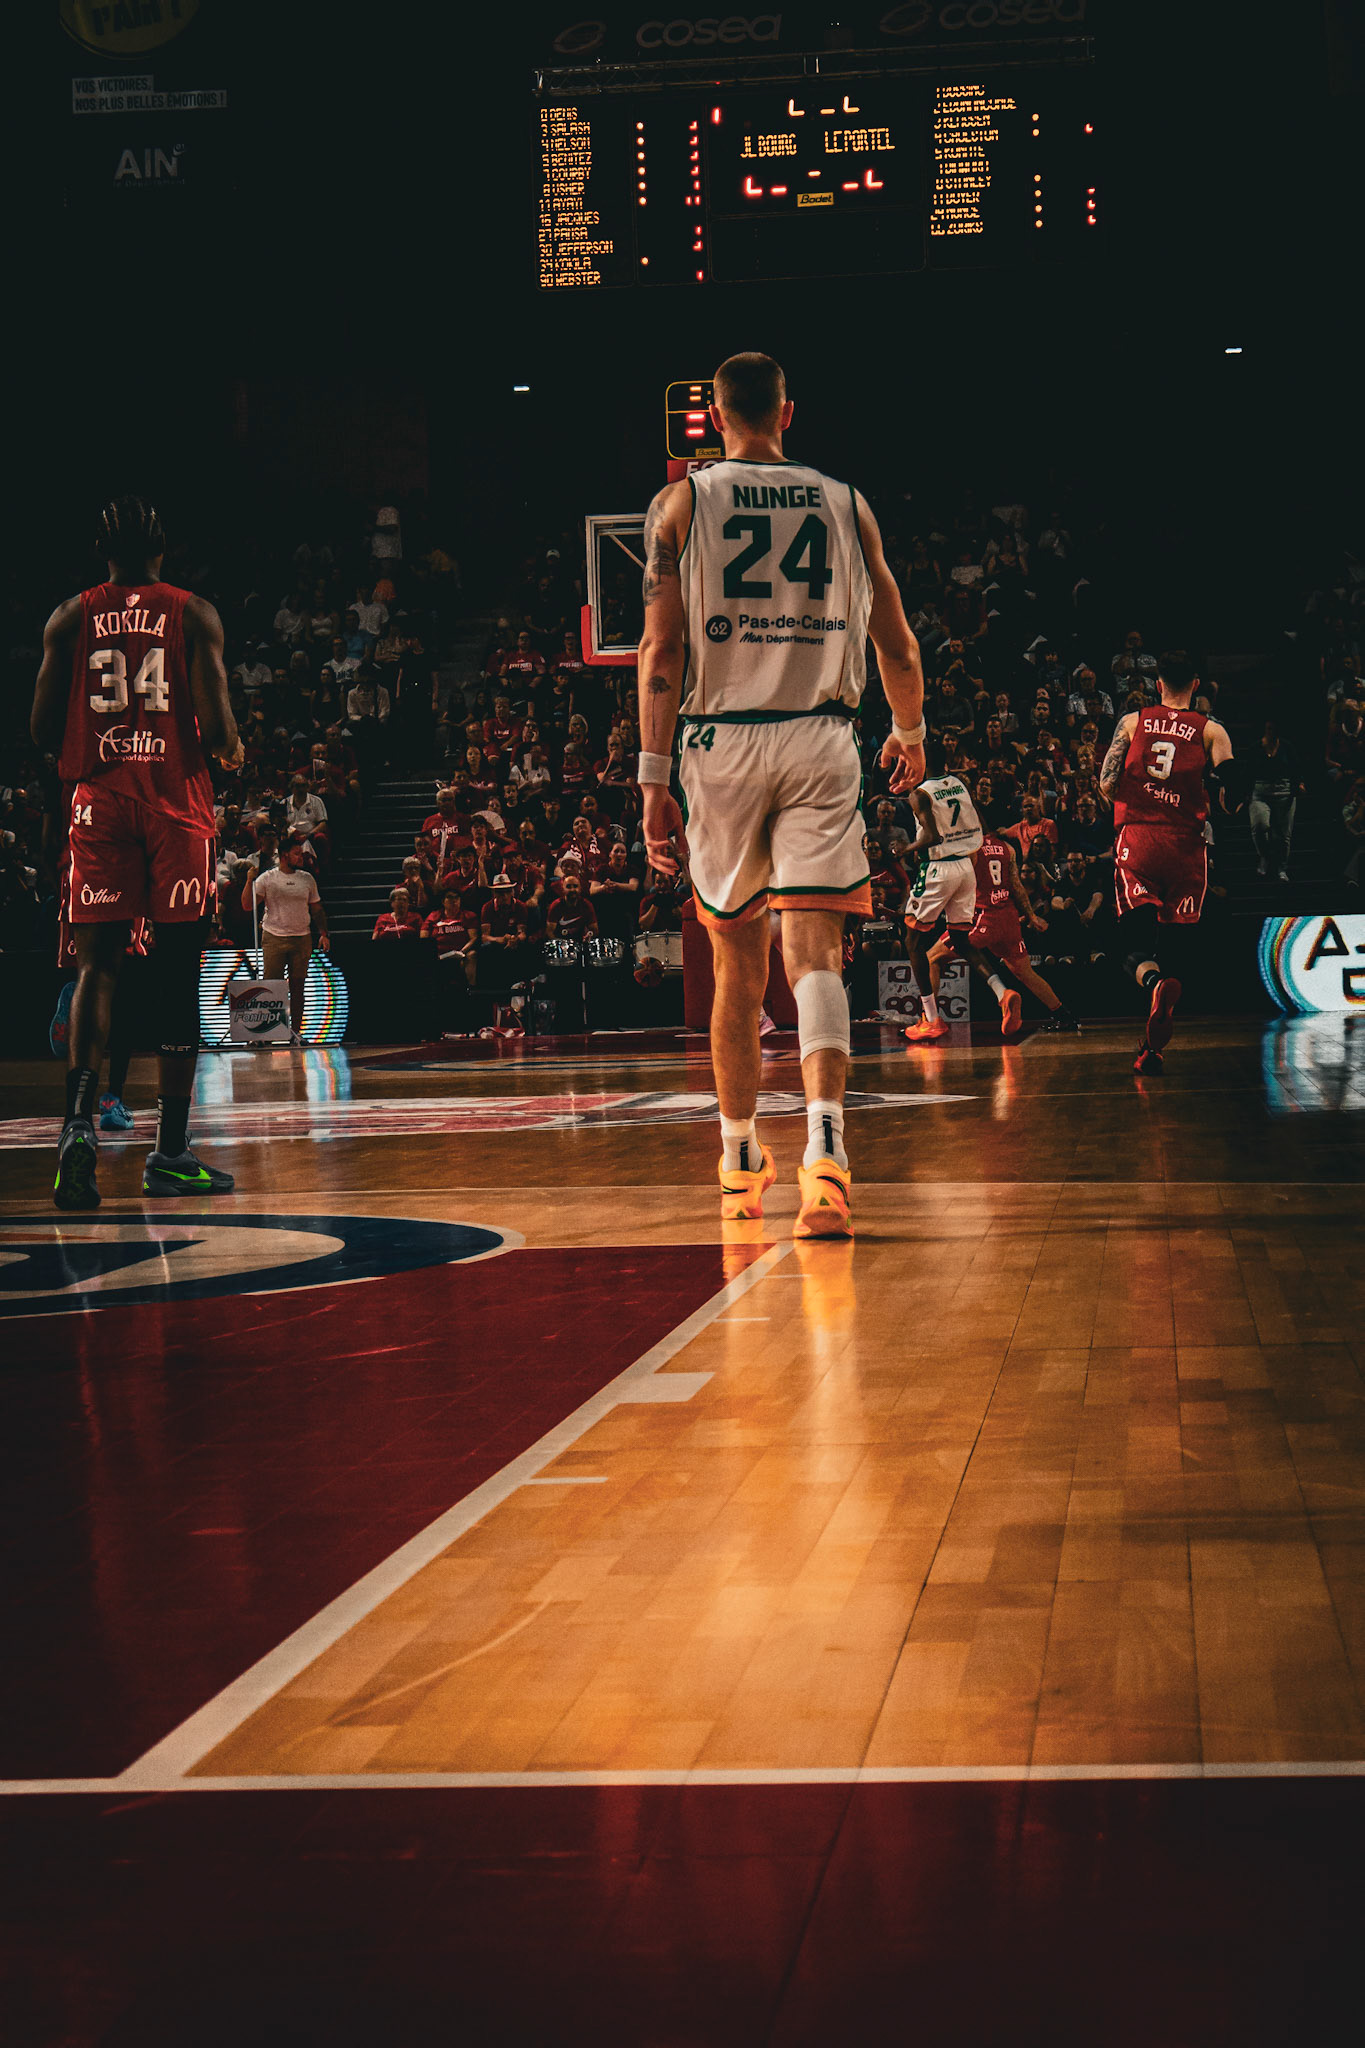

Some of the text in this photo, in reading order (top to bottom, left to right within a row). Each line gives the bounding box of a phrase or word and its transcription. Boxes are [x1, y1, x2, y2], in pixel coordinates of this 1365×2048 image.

[940, 0, 1086, 30] cosea
[637, 14, 783, 48] cosea
[75, 80, 96, 93] VOS
[75, 98, 96, 111] NOS
[99, 97, 124, 110] PLUS
[127, 95, 163, 109] BELLES
[549, 107, 578, 121] DENIS
[550, 121, 590, 136] SALASH
[550, 137, 590, 151] NELSON
[114, 148, 178, 180] AIN
[551, 151, 592, 166] BENITEZ
[800, 195, 833, 204] Bodet
[732, 484, 822, 509] NUNGE
[722, 513, 833, 601] 24
[93, 608, 167, 639] KOKILA
[709, 621, 728, 636] 62
[766, 634, 824, 646] Département
[88, 647, 170, 714] 34
[688, 723, 716, 752] 24
[1143, 718, 1197, 742] SALASH
[1146, 740, 1177, 780] 3
[73, 803, 93, 826] 34
[947, 797, 961, 827] 7
[1120, 847, 1130, 861] 3
[988, 860, 1002, 886] 8
[237, 999, 285, 1009] Quinson
[885, 995, 968, 1019] BORG
